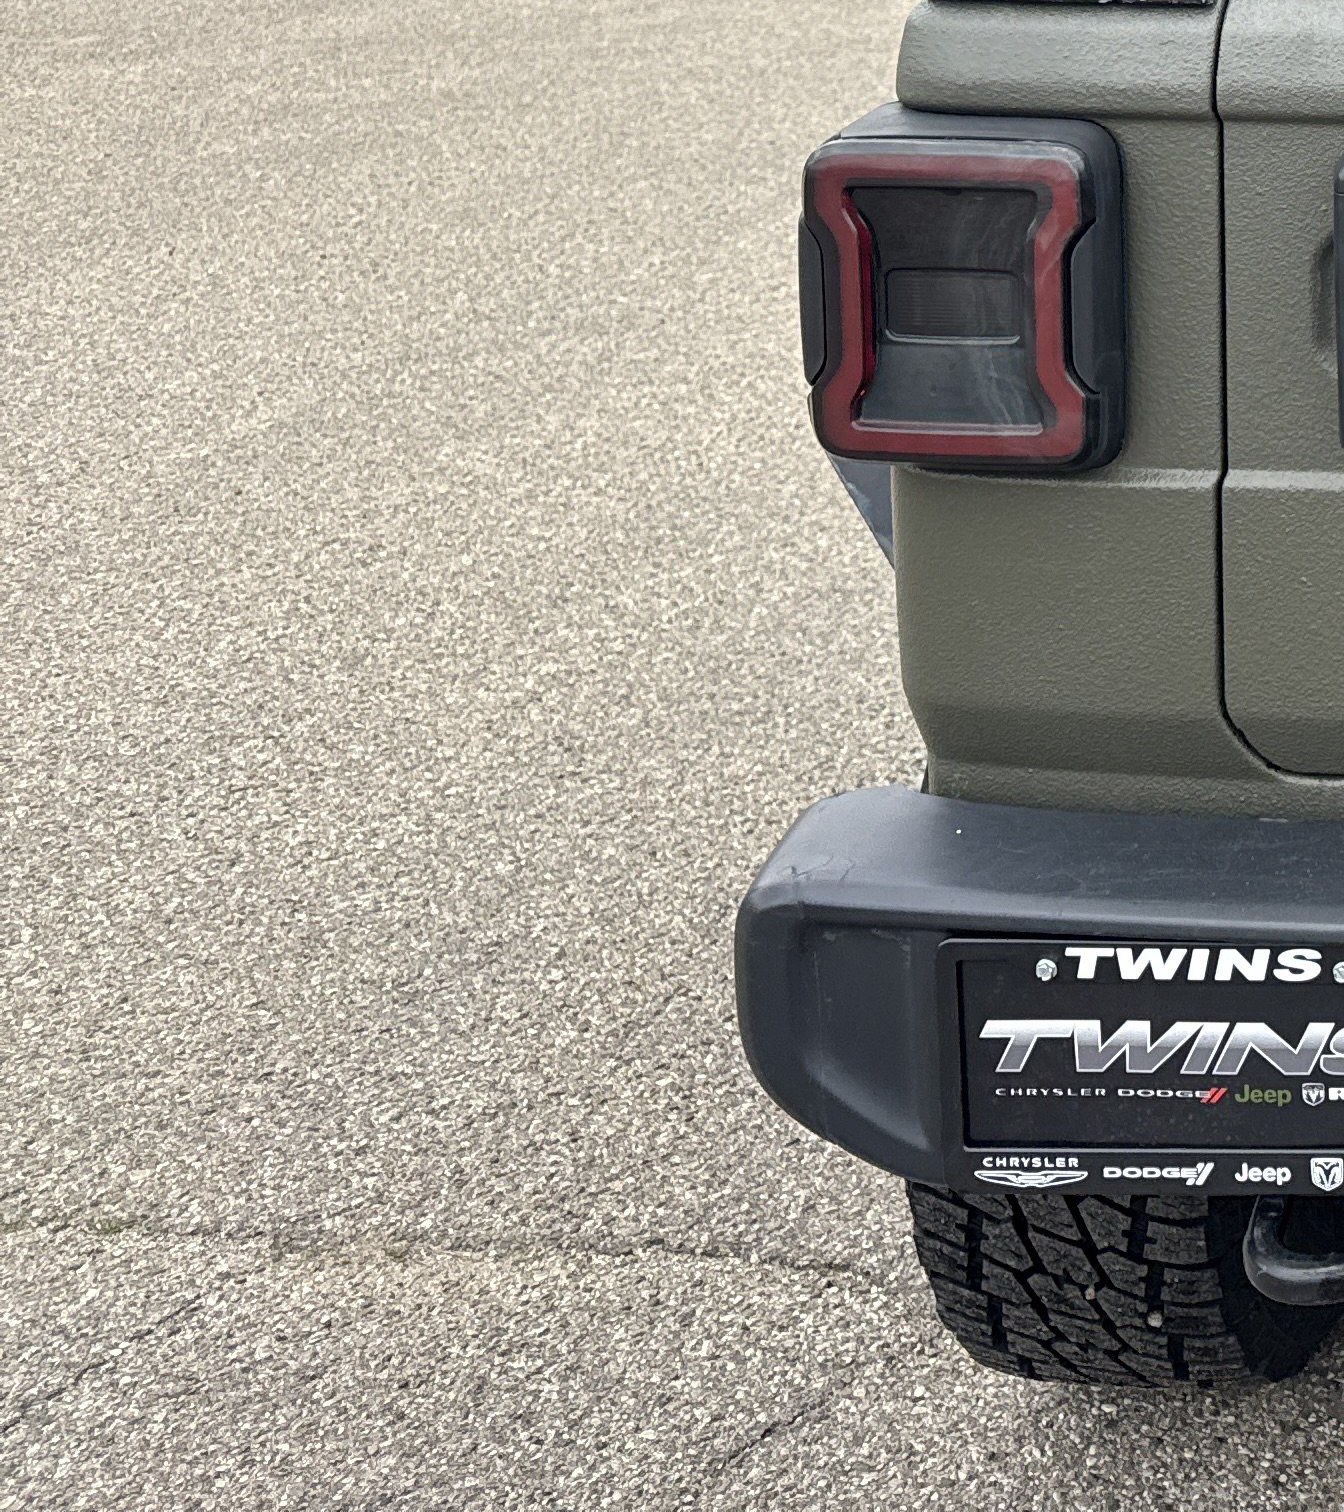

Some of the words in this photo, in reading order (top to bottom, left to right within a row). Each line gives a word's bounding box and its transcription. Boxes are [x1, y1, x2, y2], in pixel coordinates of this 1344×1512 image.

[1064, 947, 1322, 982] TWINS
[995, 1087, 1106, 1097] CHRYSLER
[1117, 1087, 1211, 1098] DODGE
[1234, 1084, 1292, 1106] Jeep
[982, 1156, 1079, 1169] CHRYSLER
[1103, 1166, 1199, 1179] DODGE
[1234, 1162, 1292, 1185] Jeep
